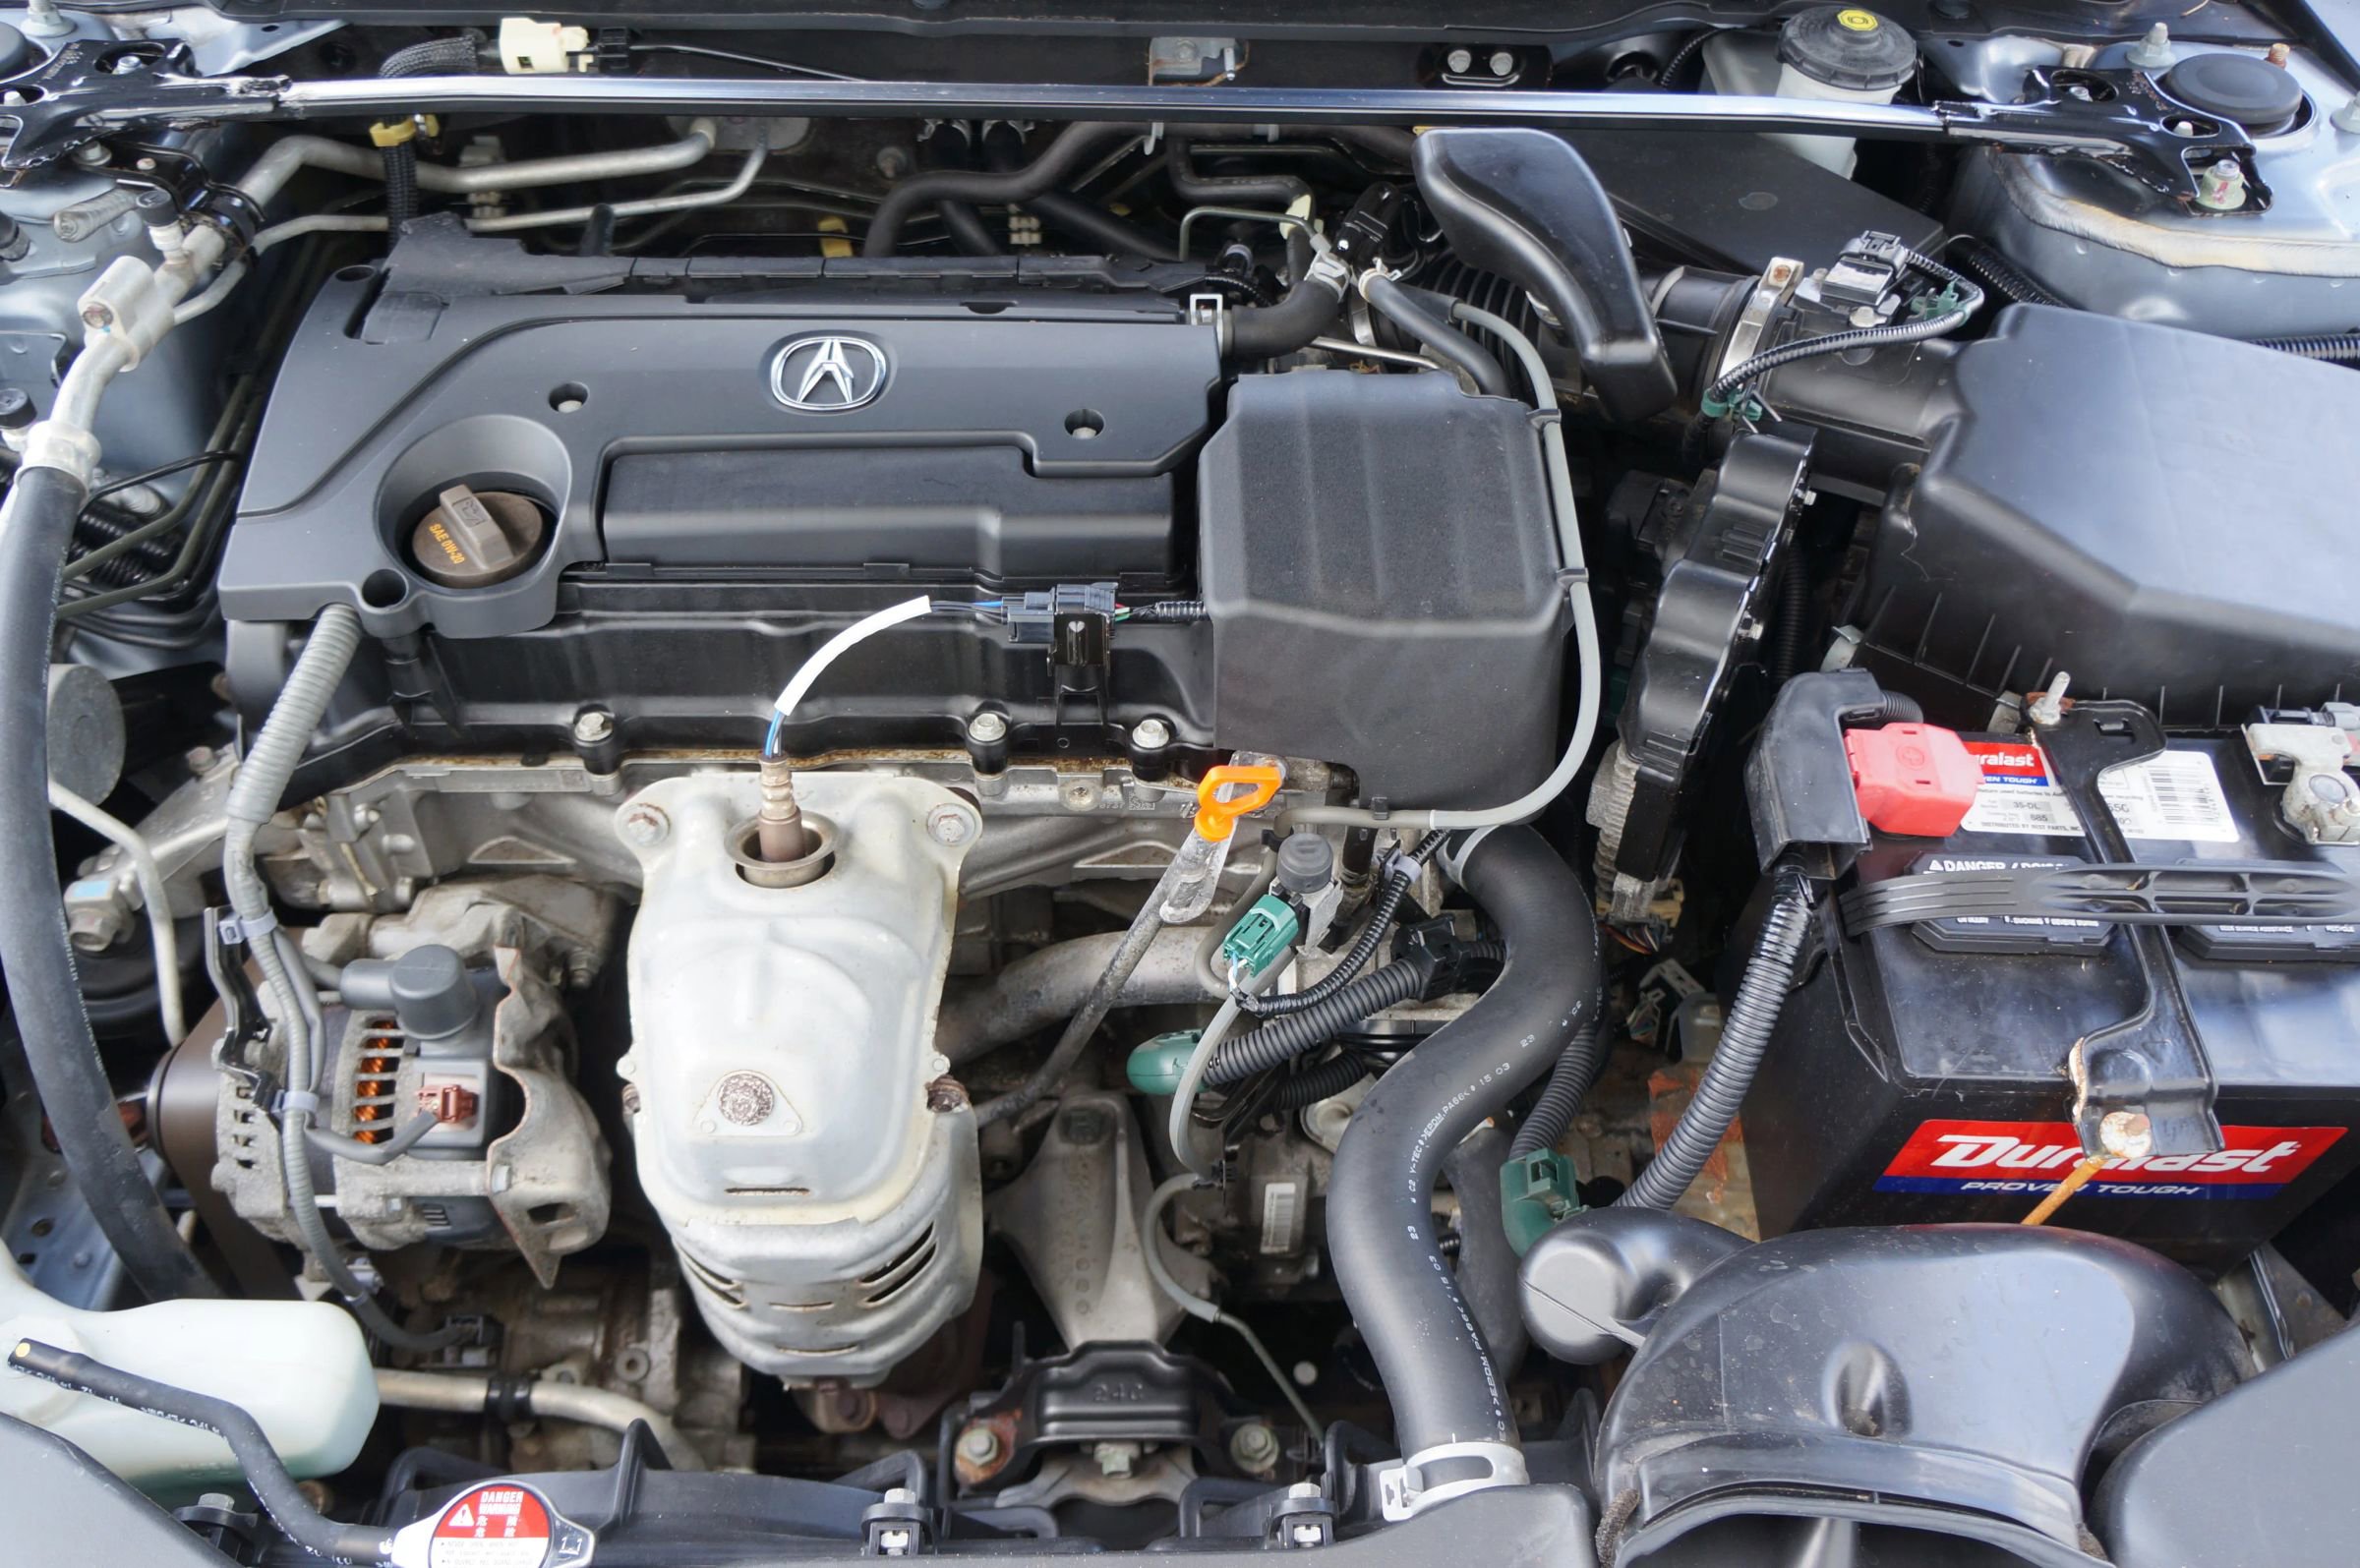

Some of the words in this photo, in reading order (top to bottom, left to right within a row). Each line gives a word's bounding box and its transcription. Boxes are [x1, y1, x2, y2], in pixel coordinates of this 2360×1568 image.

[429, 523, 449, 542] SAE
[441, 540, 465, 564] 0W-20
[1977, 752, 2035, 767] ralast
[1930, 1134, 2297, 1173] Durast
[2098, 1184, 2201, 1195] TOUGH
[480, 1490, 525, 1503] DANGER
